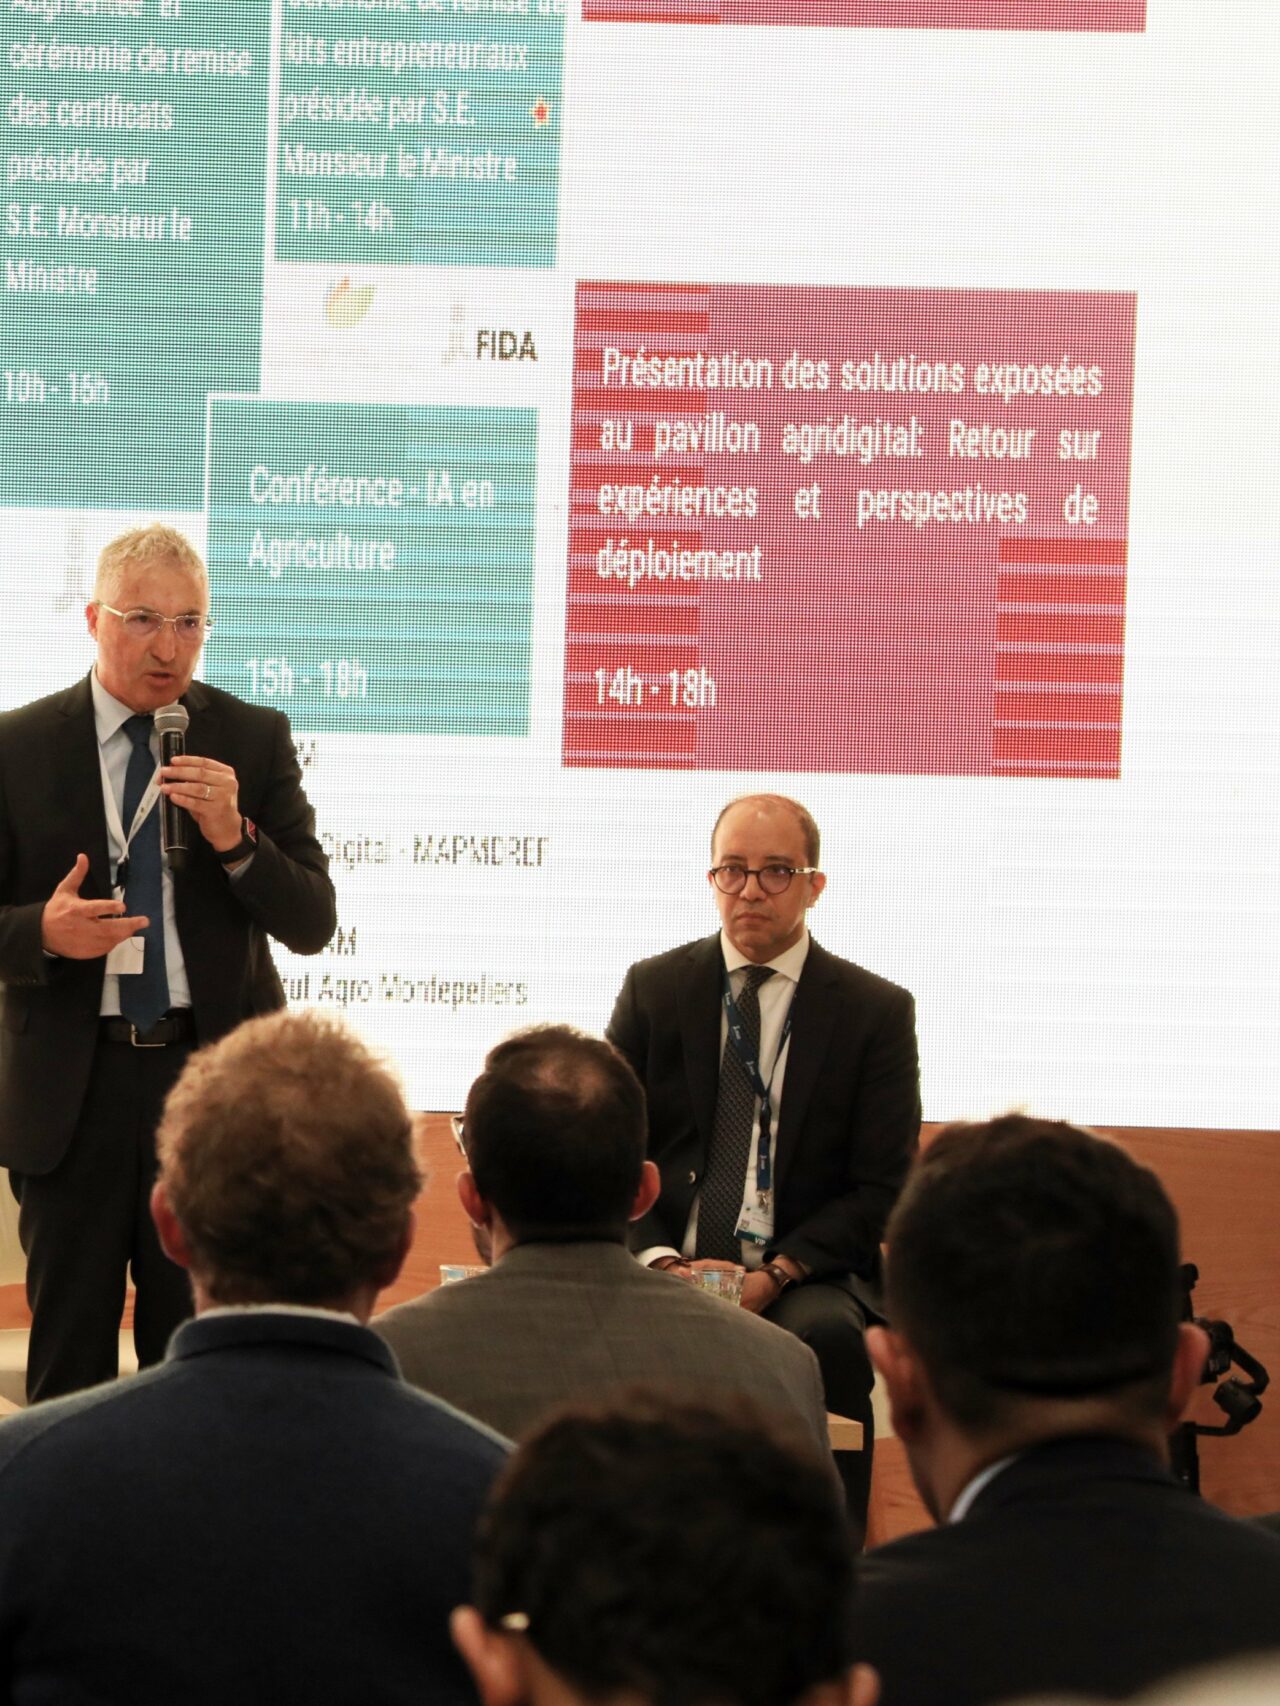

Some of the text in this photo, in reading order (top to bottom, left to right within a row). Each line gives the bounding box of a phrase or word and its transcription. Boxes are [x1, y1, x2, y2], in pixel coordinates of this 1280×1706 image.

[10, 33, 252, 75] cérémonie de remise
[284, 30, 529, 76] kits entrepreneuriaux
[8, 92, 174, 131] des certificats
[282, 86, 476, 131] présidée par S.E.
[7, 147, 106, 188] présidée
[112, 157, 151, 192] par
[284, 142, 518, 183] Monsieur le Ministre
[5, 204, 193, 241] S.E. Monsieur le
[289, 199, 330, 232] 11h
[354, 200, 394, 234] 14h
[5, 259, 99, 295] Ministre
[476, 330, 538, 361] FIDA
[4, 369, 46, 403] 10h
[603, 345, 1103, 402] Présentation des solutions exposées
[599, 413, 1101, 465] au pavillon agridigital: Retour sur
[249, 464, 402, 507] Conférence
[424, 469, 453, 505] IA
[460, 477, 494, 508] en
[597, 475, 1098, 528] expériences et perspectives de
[248, 529, 397, 577] Agriculture
[595, 538, 763, 588] déploiement
[244, 656, 293, 696] 15h
[593, 667, 643, 706] 14h
[668, 667, 716, 708] 18h
